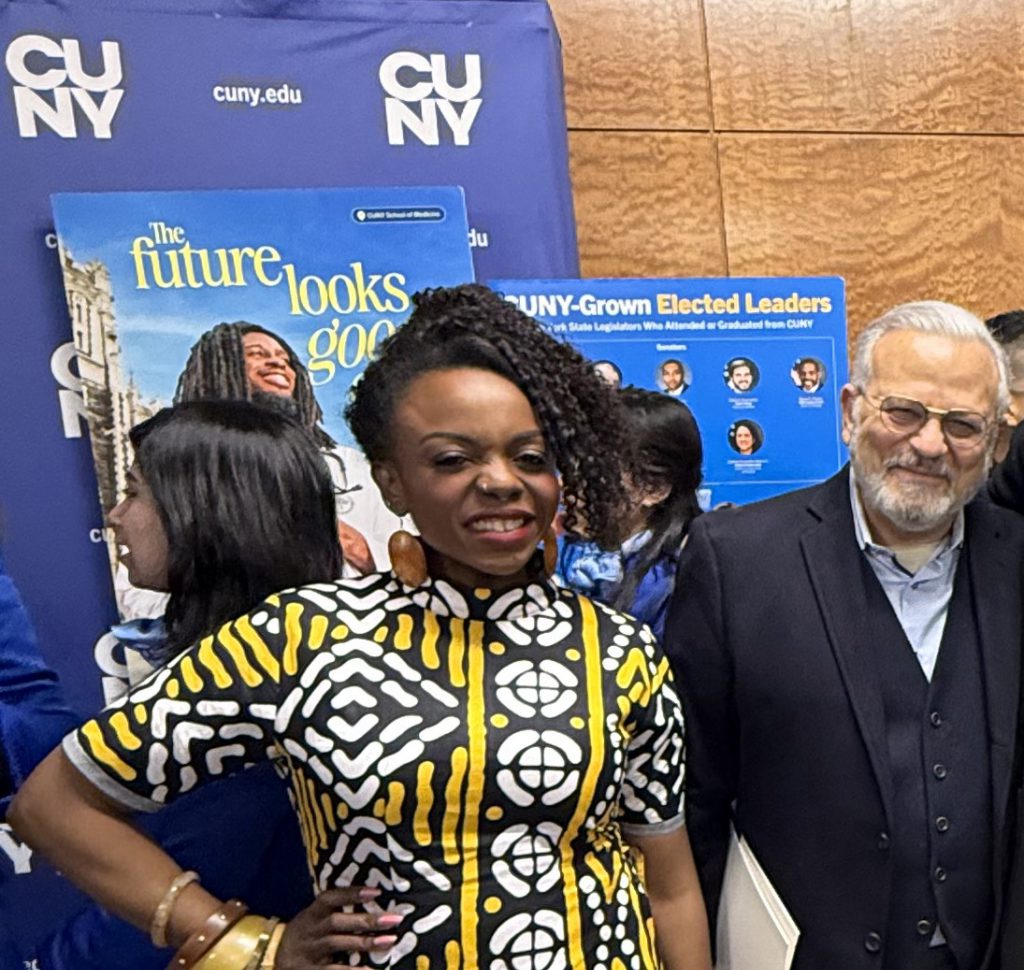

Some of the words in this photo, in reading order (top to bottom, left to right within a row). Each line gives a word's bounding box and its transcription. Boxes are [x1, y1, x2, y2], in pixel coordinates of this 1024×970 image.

[212, 83, 303, 107] cuny.edu
[149, 222, 186, 245] The
[129, 236, 284, 289] future
[282, 261, 410, 316] looks
[656, 293, 740, 315] Elected
[745, 292, 832, 314] Leaders
[568, 322, 593, 331] State
[594, 321, 642, 333] Legislators
[643, 321, 663, 330] Who
[665, 320, 706, 330] Attended
[707, 322, 717, 330] or
[717, 320, 763, 330] Graduated
[764, 319, 786, 329] from
[786, 319, 814, 329] CUNY
